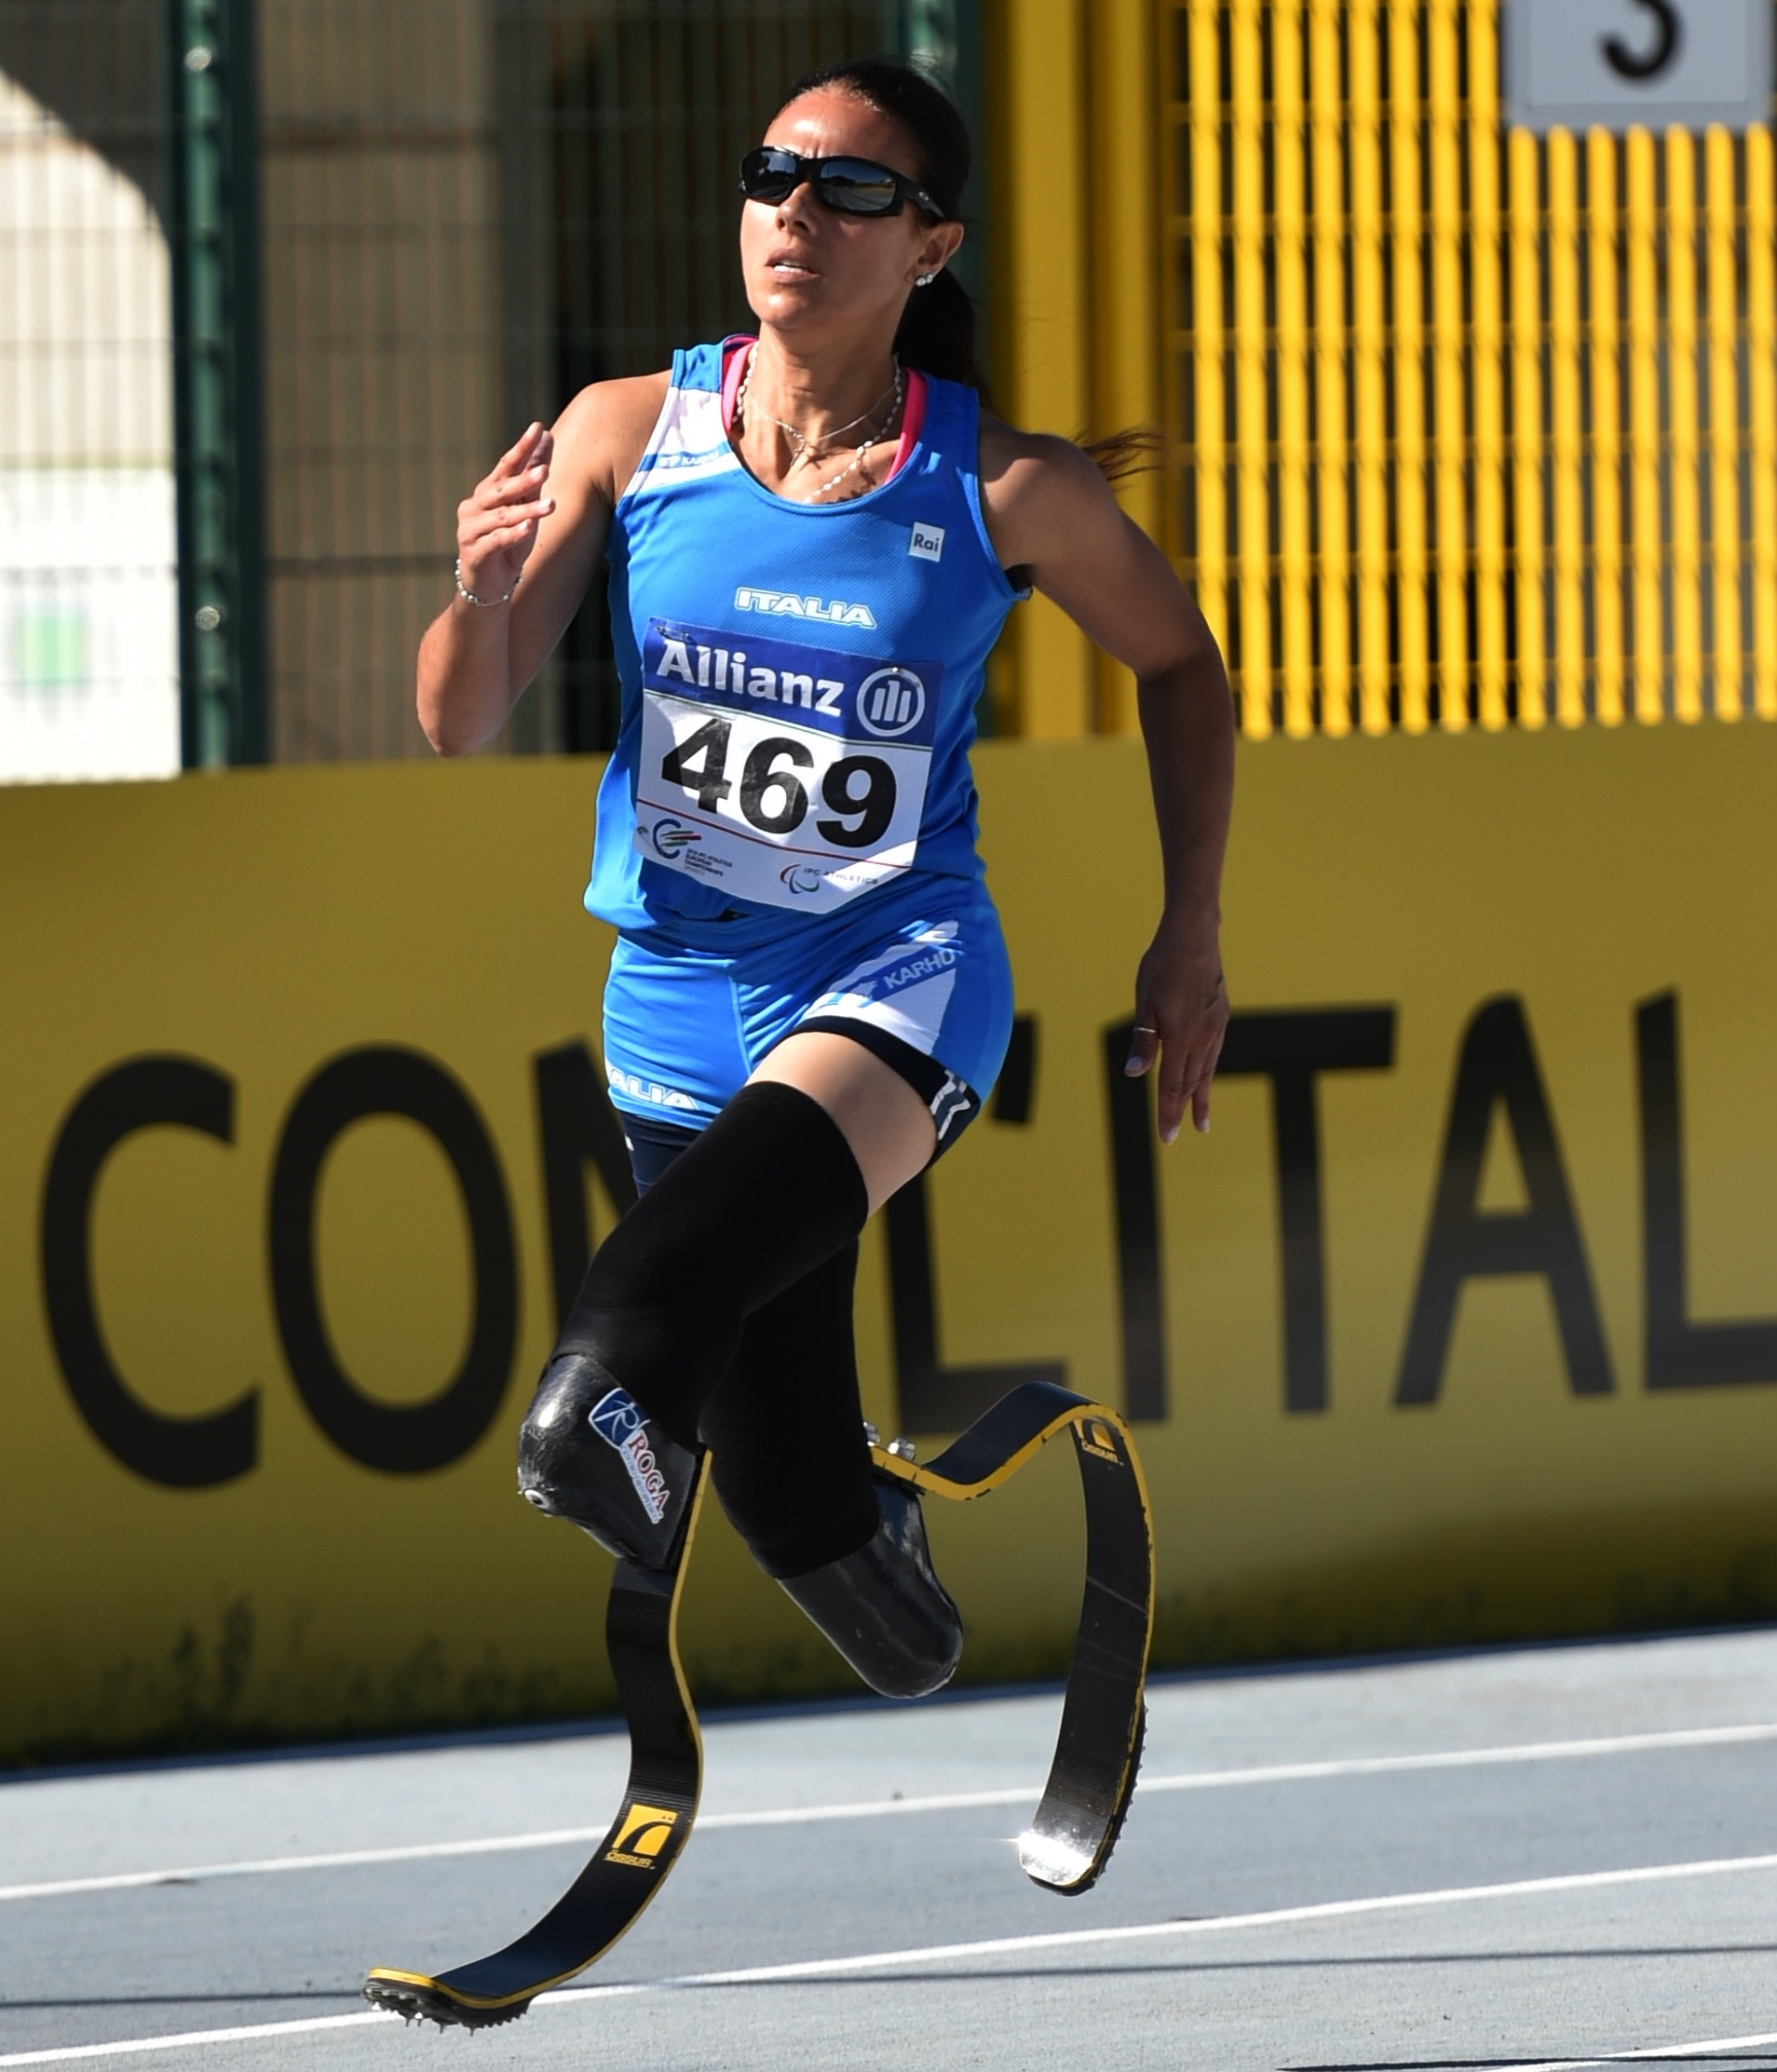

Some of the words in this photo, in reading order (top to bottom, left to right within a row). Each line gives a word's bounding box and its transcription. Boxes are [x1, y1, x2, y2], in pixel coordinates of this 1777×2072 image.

[913, 533, 940, 552] Rai
[735, 588, 876, 630] ITALIA
[656, 639, 845, 718] Allianz
[660, 717, 898, 849] 469
